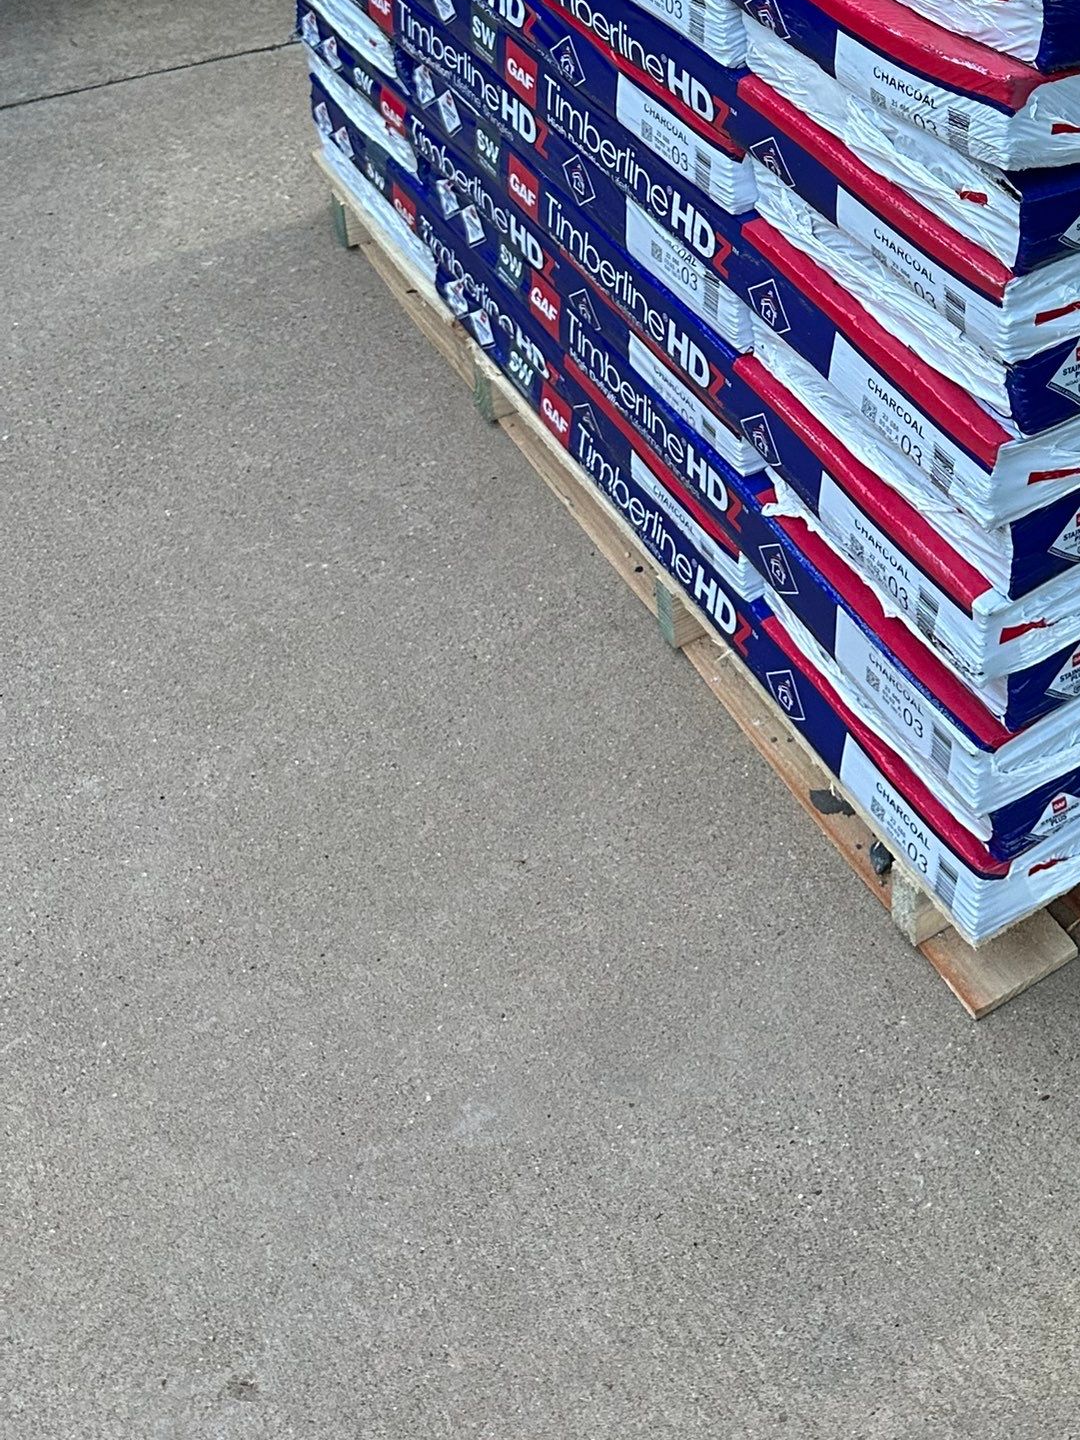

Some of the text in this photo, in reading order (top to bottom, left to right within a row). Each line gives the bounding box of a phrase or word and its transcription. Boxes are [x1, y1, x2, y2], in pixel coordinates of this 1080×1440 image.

[872, 65, 938, 111] CHARCOAL
[643, 102, 689, 147] CHARCOAL
[476, 128, 500, 165] SW
[509, 172, 537, 207] GAF
[671, 145, 690, 172] 03
[542, 397, 569, 434] GAF
[866, 377, 926, 440] CHARCOAL
[900, 434, 924, 468] 03
[853, 518, 911, 584] CHARCOAL
[887, 575, 910, 611] 03
[876, 781, 931, 852] CHARCOAL
[906, 840, 929, 876] 03
